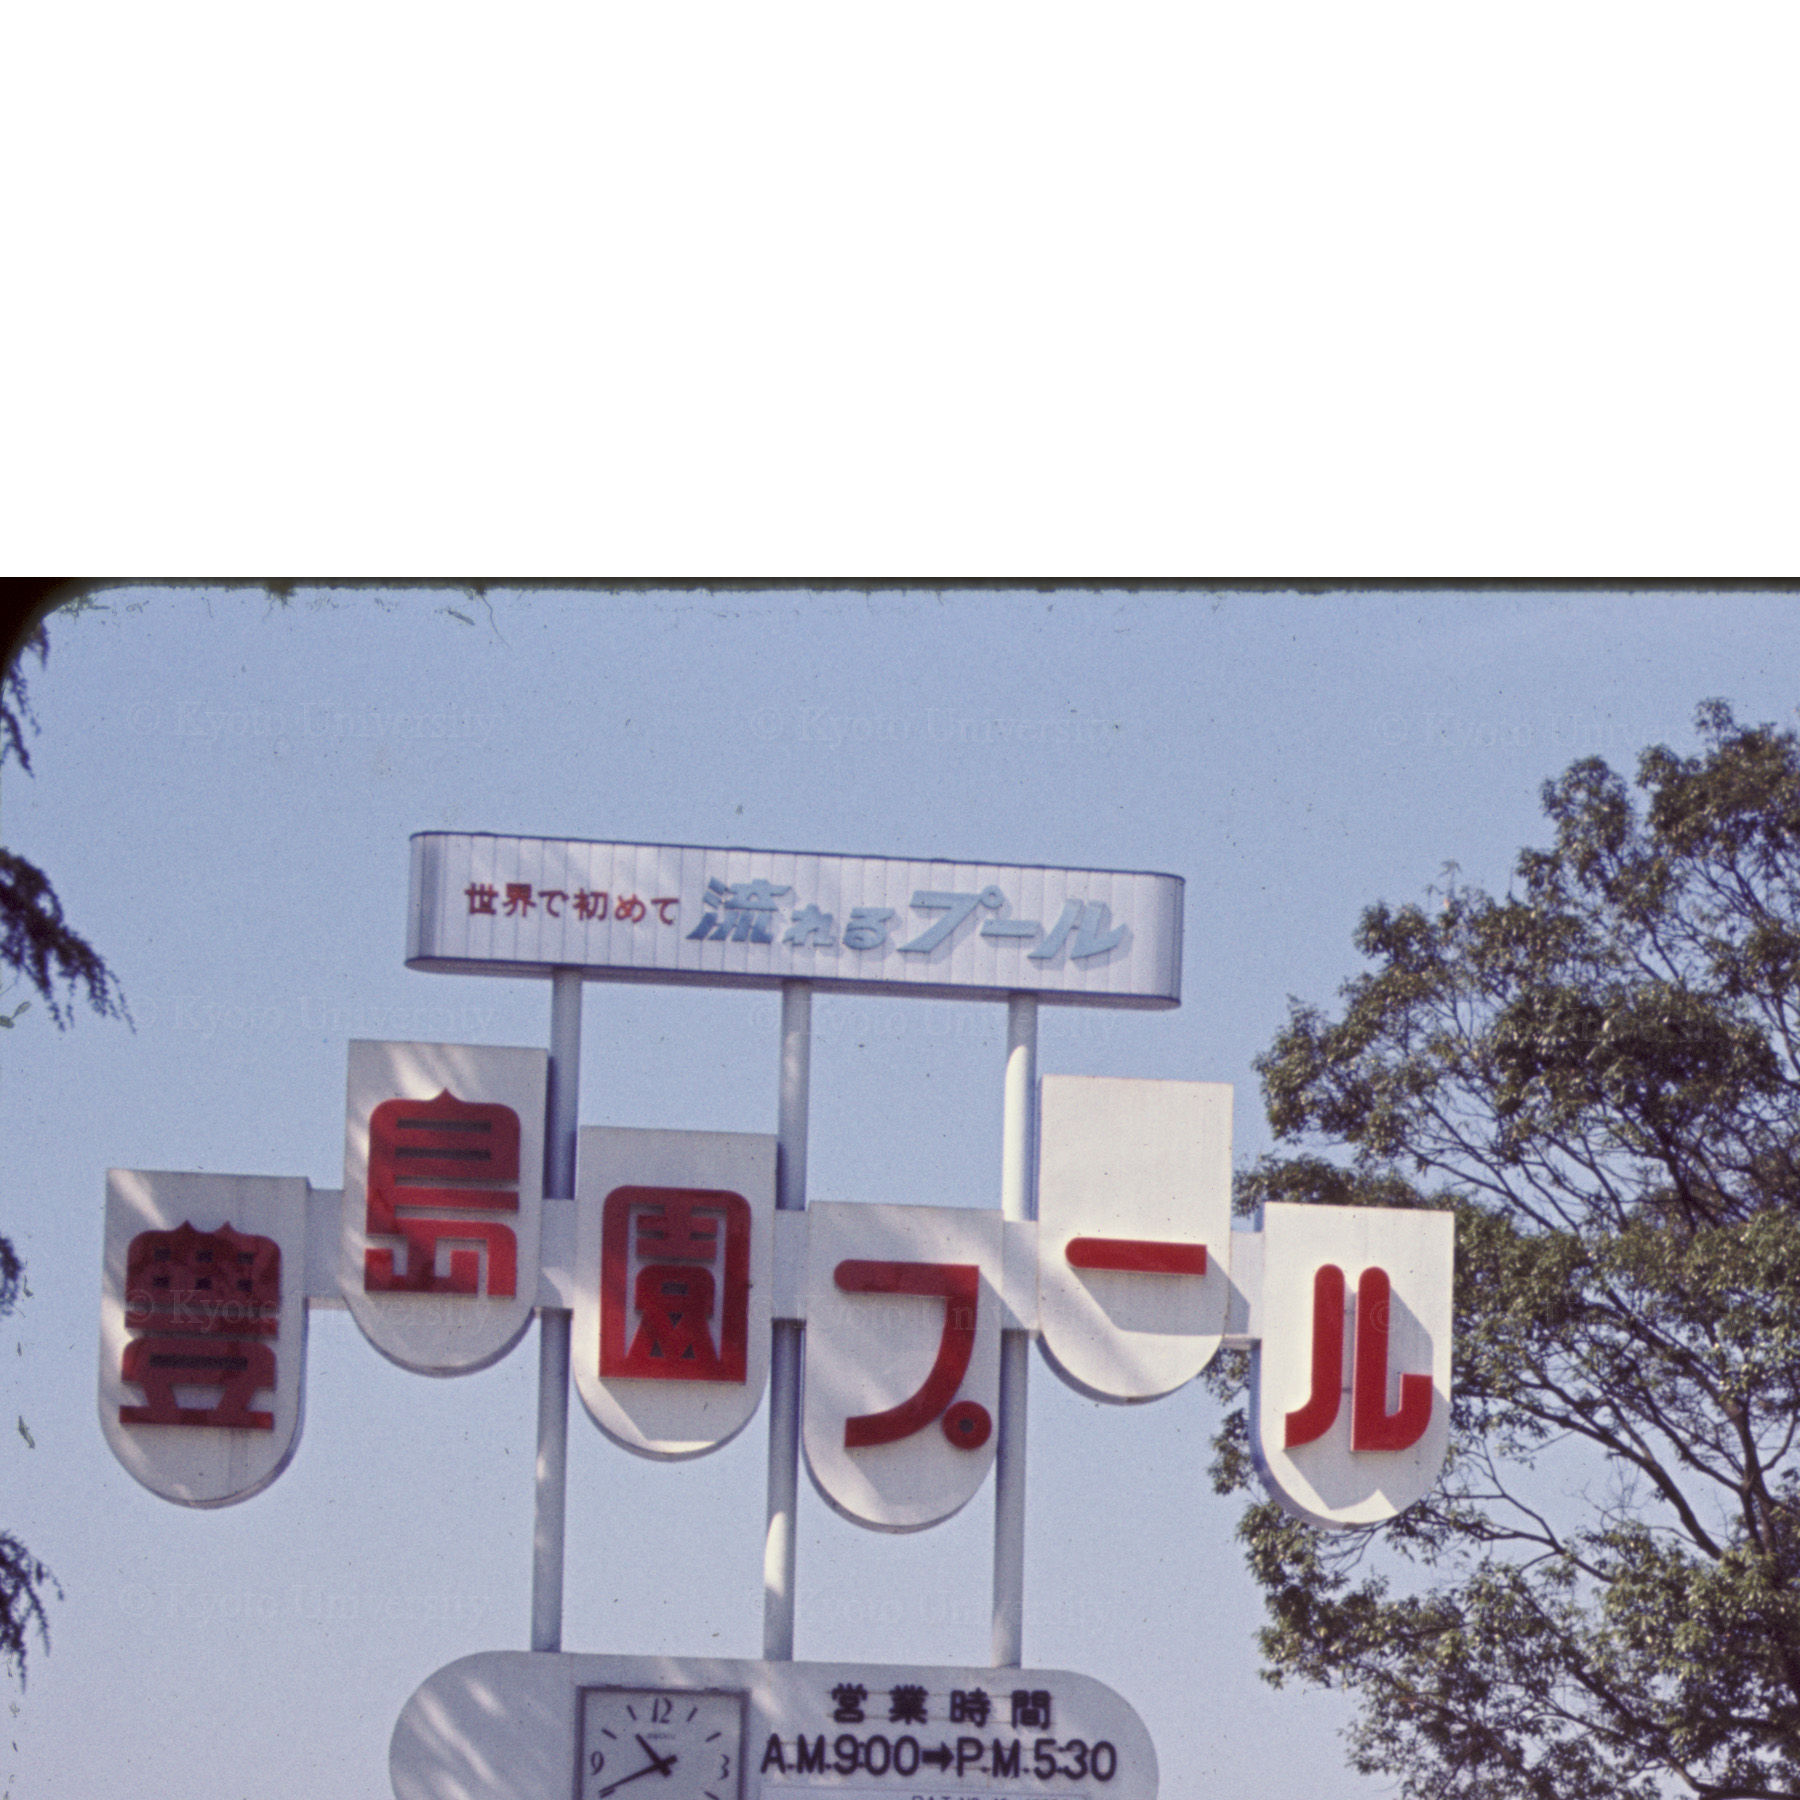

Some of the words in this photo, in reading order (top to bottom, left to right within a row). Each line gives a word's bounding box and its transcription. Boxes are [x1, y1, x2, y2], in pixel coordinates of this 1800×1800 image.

[465, 881, 680, 926] 世界で初めて
[686, 877, 1130, 962] 流れるプール
[651, 1697, 673, 1724] 12
[831, 1683, 1051, 1730] 営業時間
[590, 1750, 605, 1776] 9
[718, 1753, 731, 1780] 3
